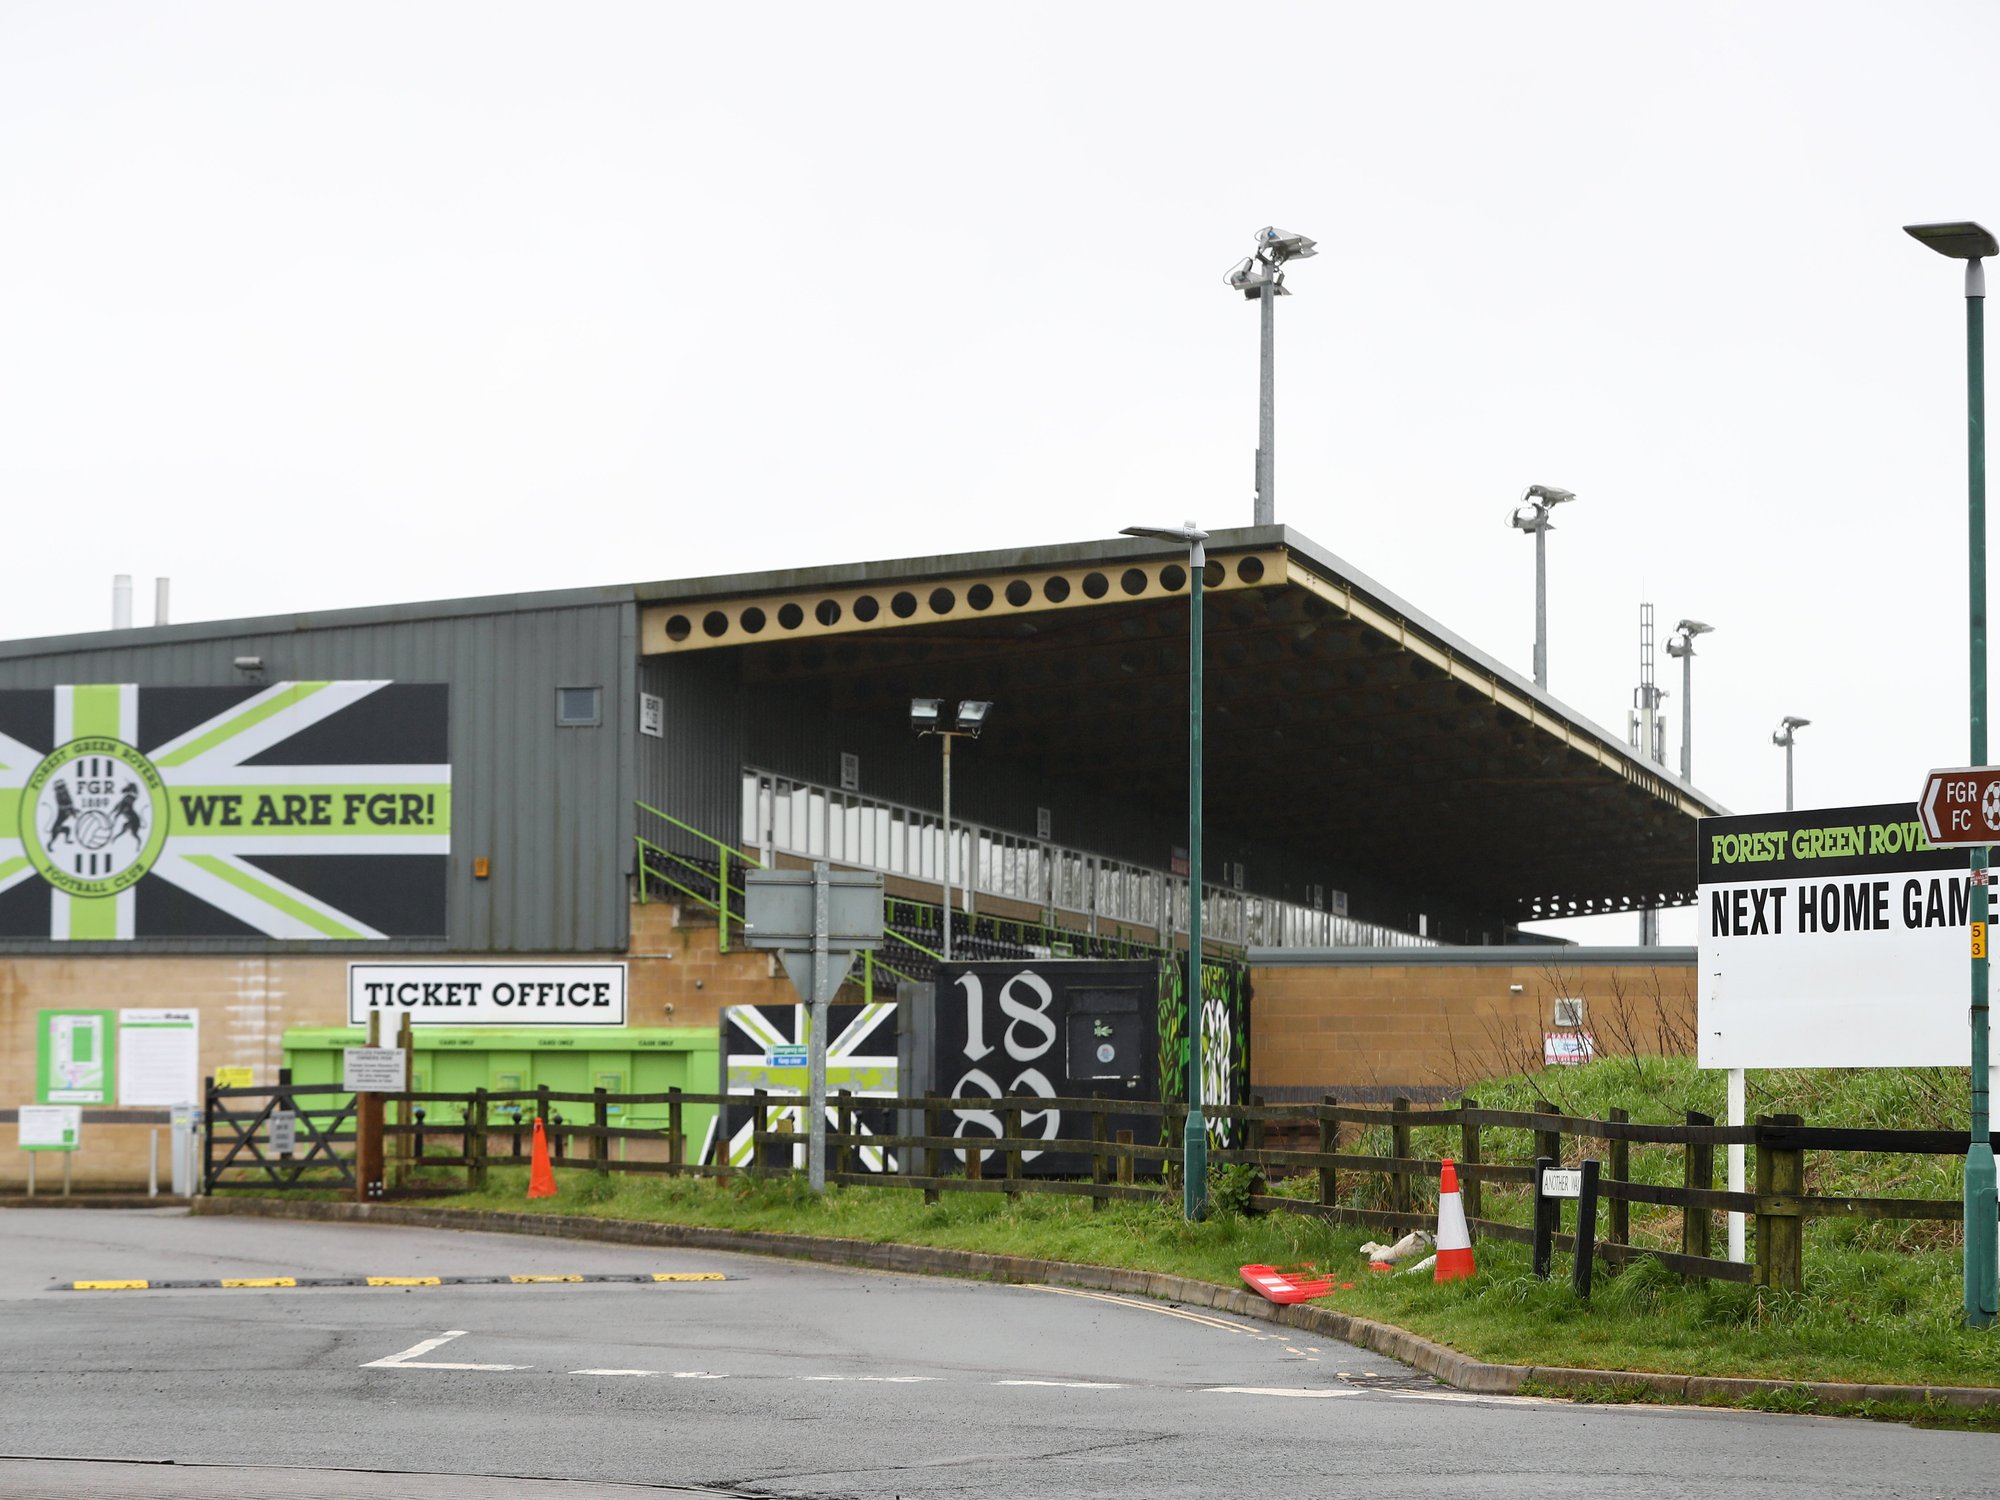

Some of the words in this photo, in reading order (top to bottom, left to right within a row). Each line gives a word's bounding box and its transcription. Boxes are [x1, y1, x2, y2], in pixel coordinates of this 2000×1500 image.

[31, 750, 67, 790] FOREST
[73, 741, 117, 753] GREEN
[122, 749, 159, 789] ROVERS
[76, 781, 115, 795] FGR
[1947, 781, 1977, 803] FGR
[180, 795, 242, 826] WE
[252, 794, 332, 826] ARE
[343, 793, 435, 826] FGR!
[1952, 809, 1971, 831] FC
[1712, 831, 1788, 864] FOREST
[1792, 825, 1865, 859] GREEN
[44, 865, 108, 892] FOOTBALL
[114, 863, 145, 888] CLUB
[1712, 887, 1787, 937] NEXT
[1798, 881, 1889, 933] HOME
[364, 983, 482, 1006] TICKET
[492, 982, 611, 1006] OFFICE
[1543, 1174, 1569, 1191] ANOTHER
